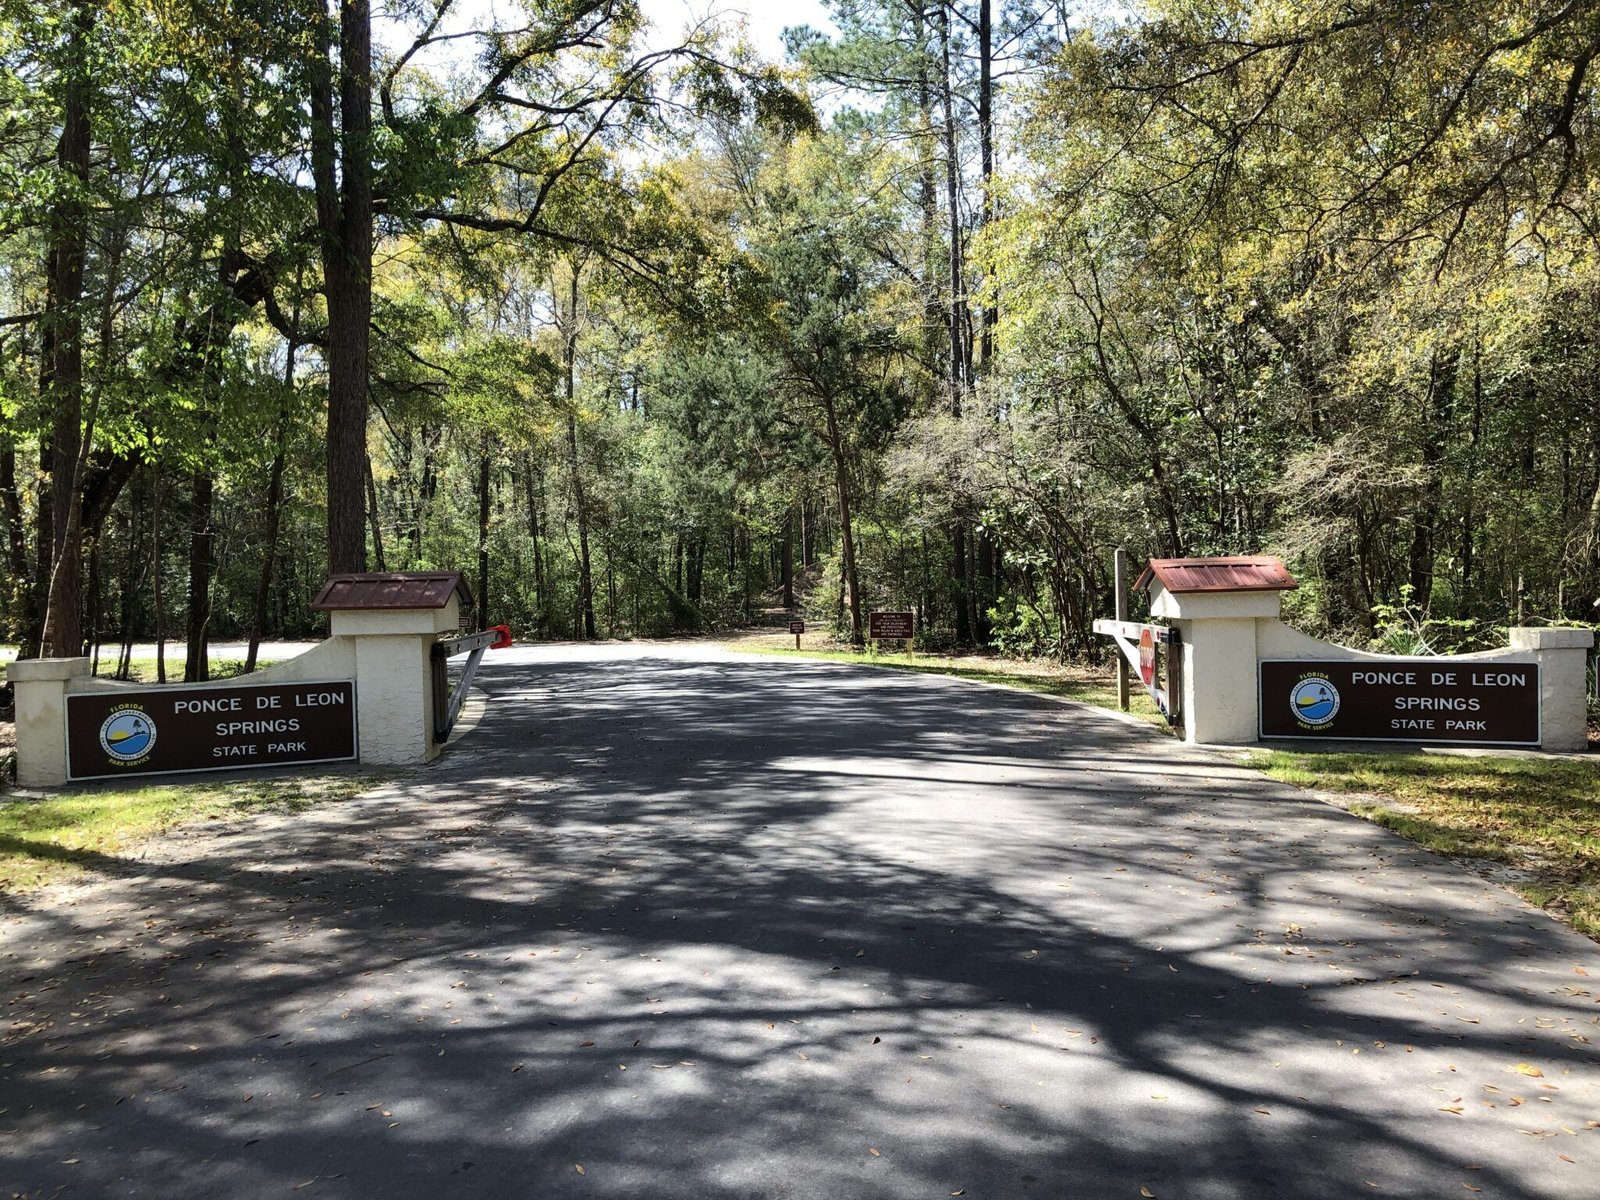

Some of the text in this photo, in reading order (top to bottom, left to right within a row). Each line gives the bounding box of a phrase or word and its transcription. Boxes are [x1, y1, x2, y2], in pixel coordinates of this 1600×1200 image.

[1140, 646, 1153, 669] STOP
[1299, 671, 1329, 680] FLORIDA
[1352, 672, 1526, 687] PONCE DE LEON
[110, 703, 144, 713] FLORIDA
[174, 692, 345, 714] PONCE DE LEON
[1394, 697, 1481, 711] SPRINGS
[216, 718, 300, 736] SPRINGS
[1296, 721, 1334, 731] PARK SERVICE
[1391, 719, 1487, 731] STATE PARK
[212, 741, 306, 758] STATE PARK
[108, 755, 151, 767] PARK SERVICE
